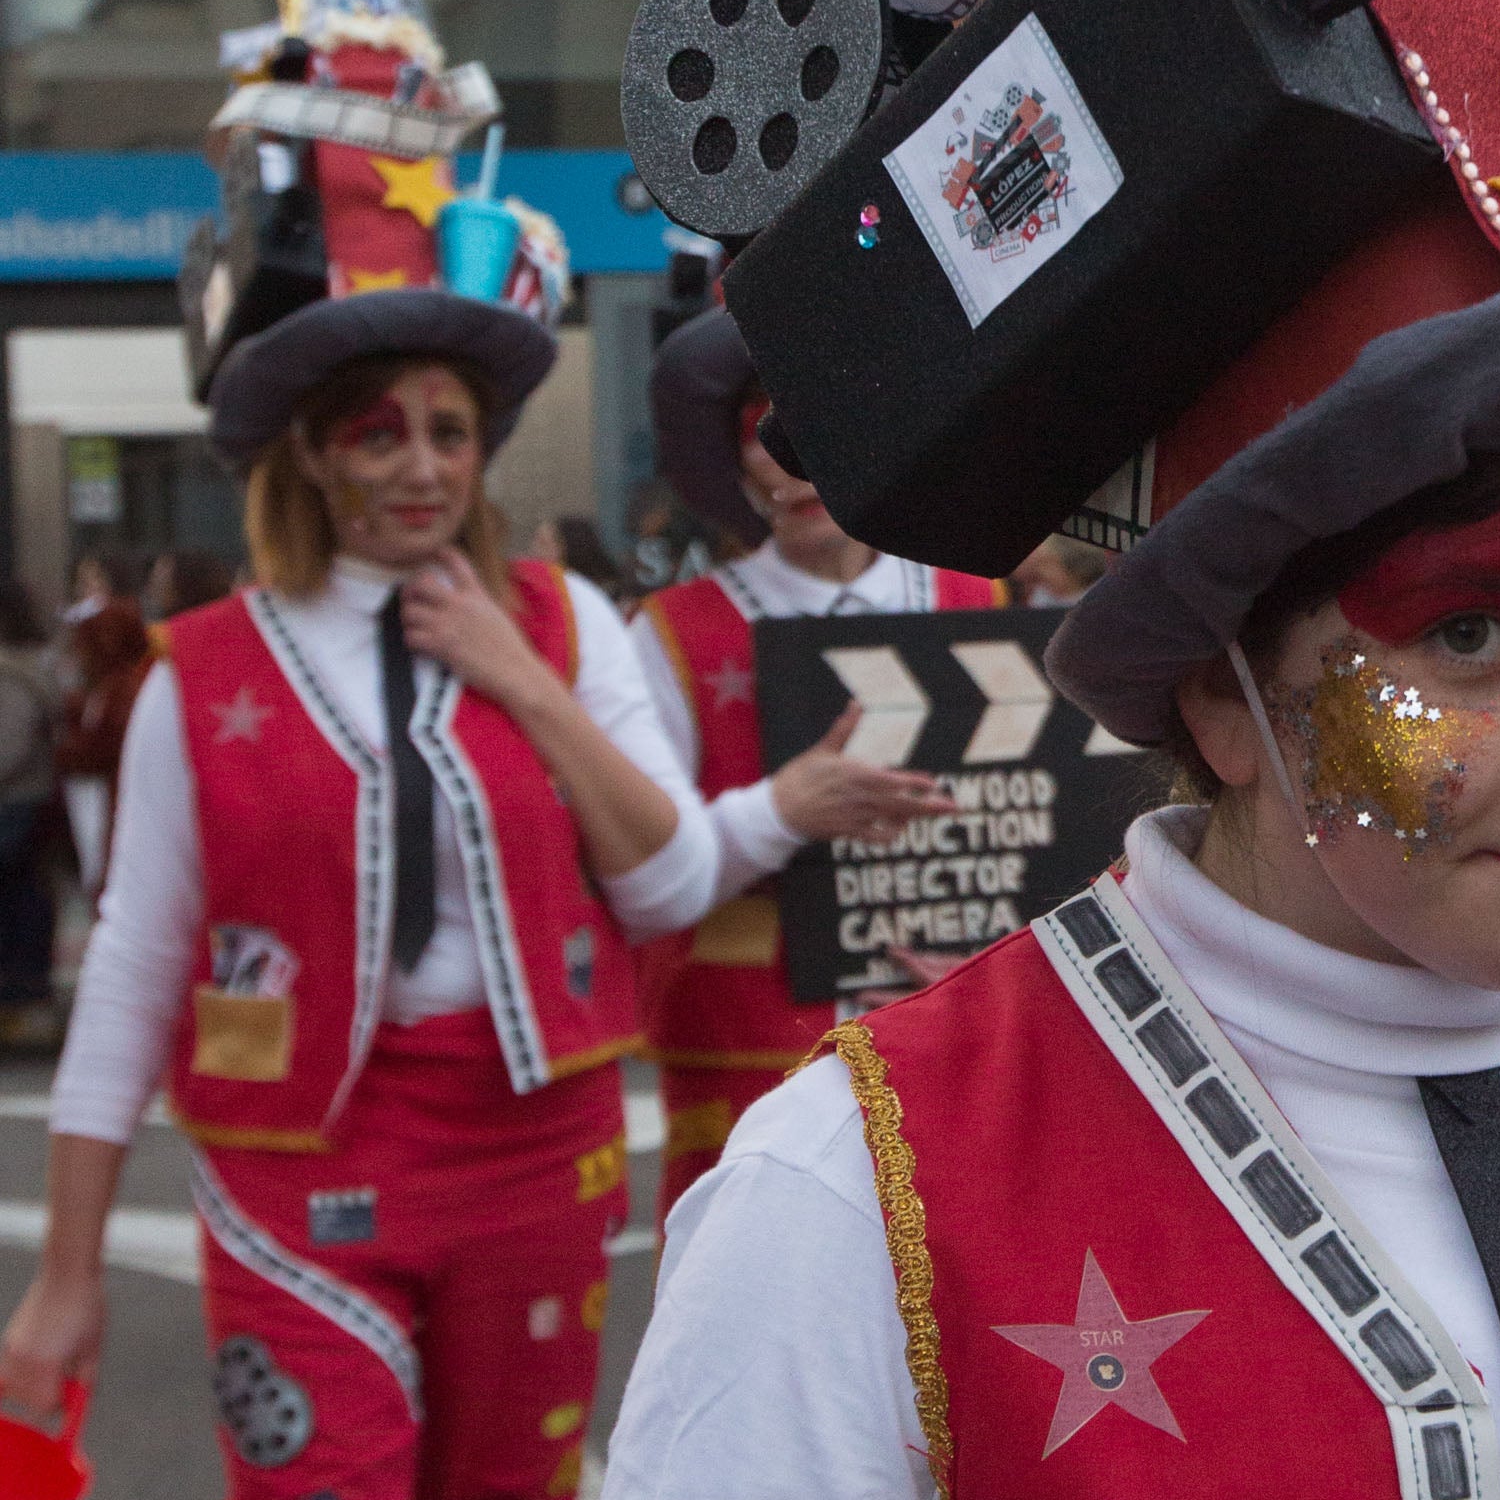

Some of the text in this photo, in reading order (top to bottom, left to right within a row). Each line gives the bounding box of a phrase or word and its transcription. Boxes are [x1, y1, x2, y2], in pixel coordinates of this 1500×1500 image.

[990, 158, 1034, 202] LÓPEZ
[835, 853, 1026, 907] DIRECTOR
[839, 898, 1024, 954] CAMERA
[1080, 1330, 1125, 1348] STAR
